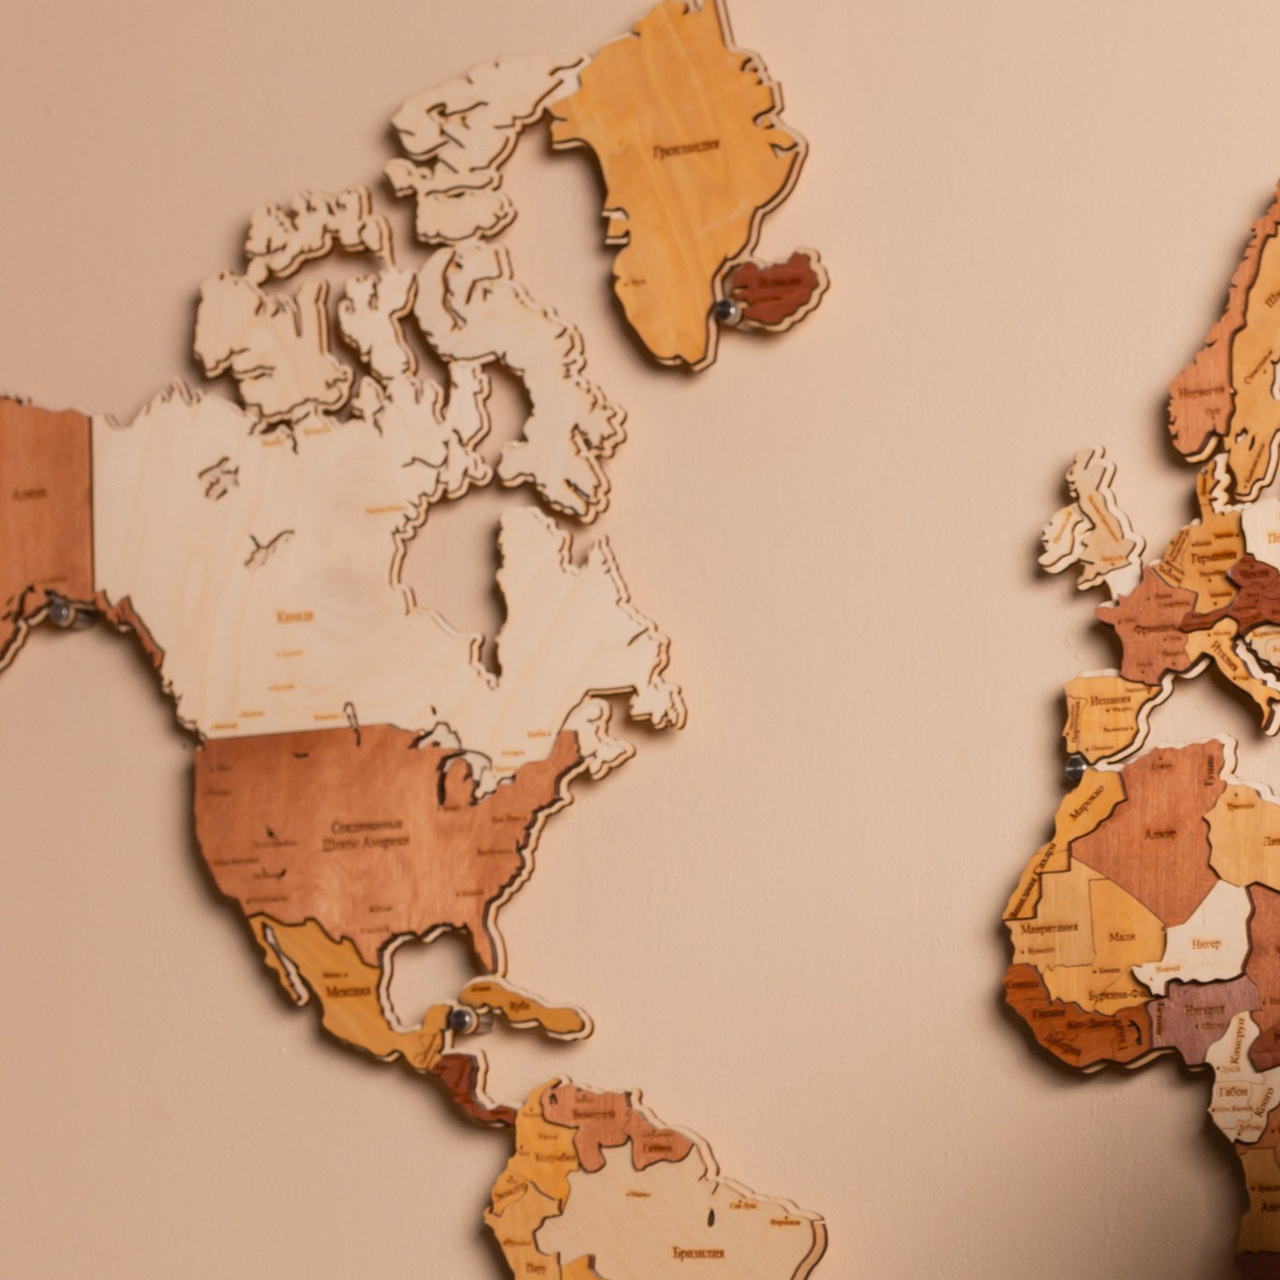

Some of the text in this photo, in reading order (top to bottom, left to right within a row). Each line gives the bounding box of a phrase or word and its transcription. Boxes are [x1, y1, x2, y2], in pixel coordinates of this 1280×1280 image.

[1069, 783, 1105, 823] Марокко
[1109, 931, 1136, 943] Мали
[1192, 938, 1222, 952] Нигер
[1219, 1085, 1249, 1098] Габон
[672, 1246, 726, 1261] Бразилия
[526, 1262, 547, 1275] Перу
